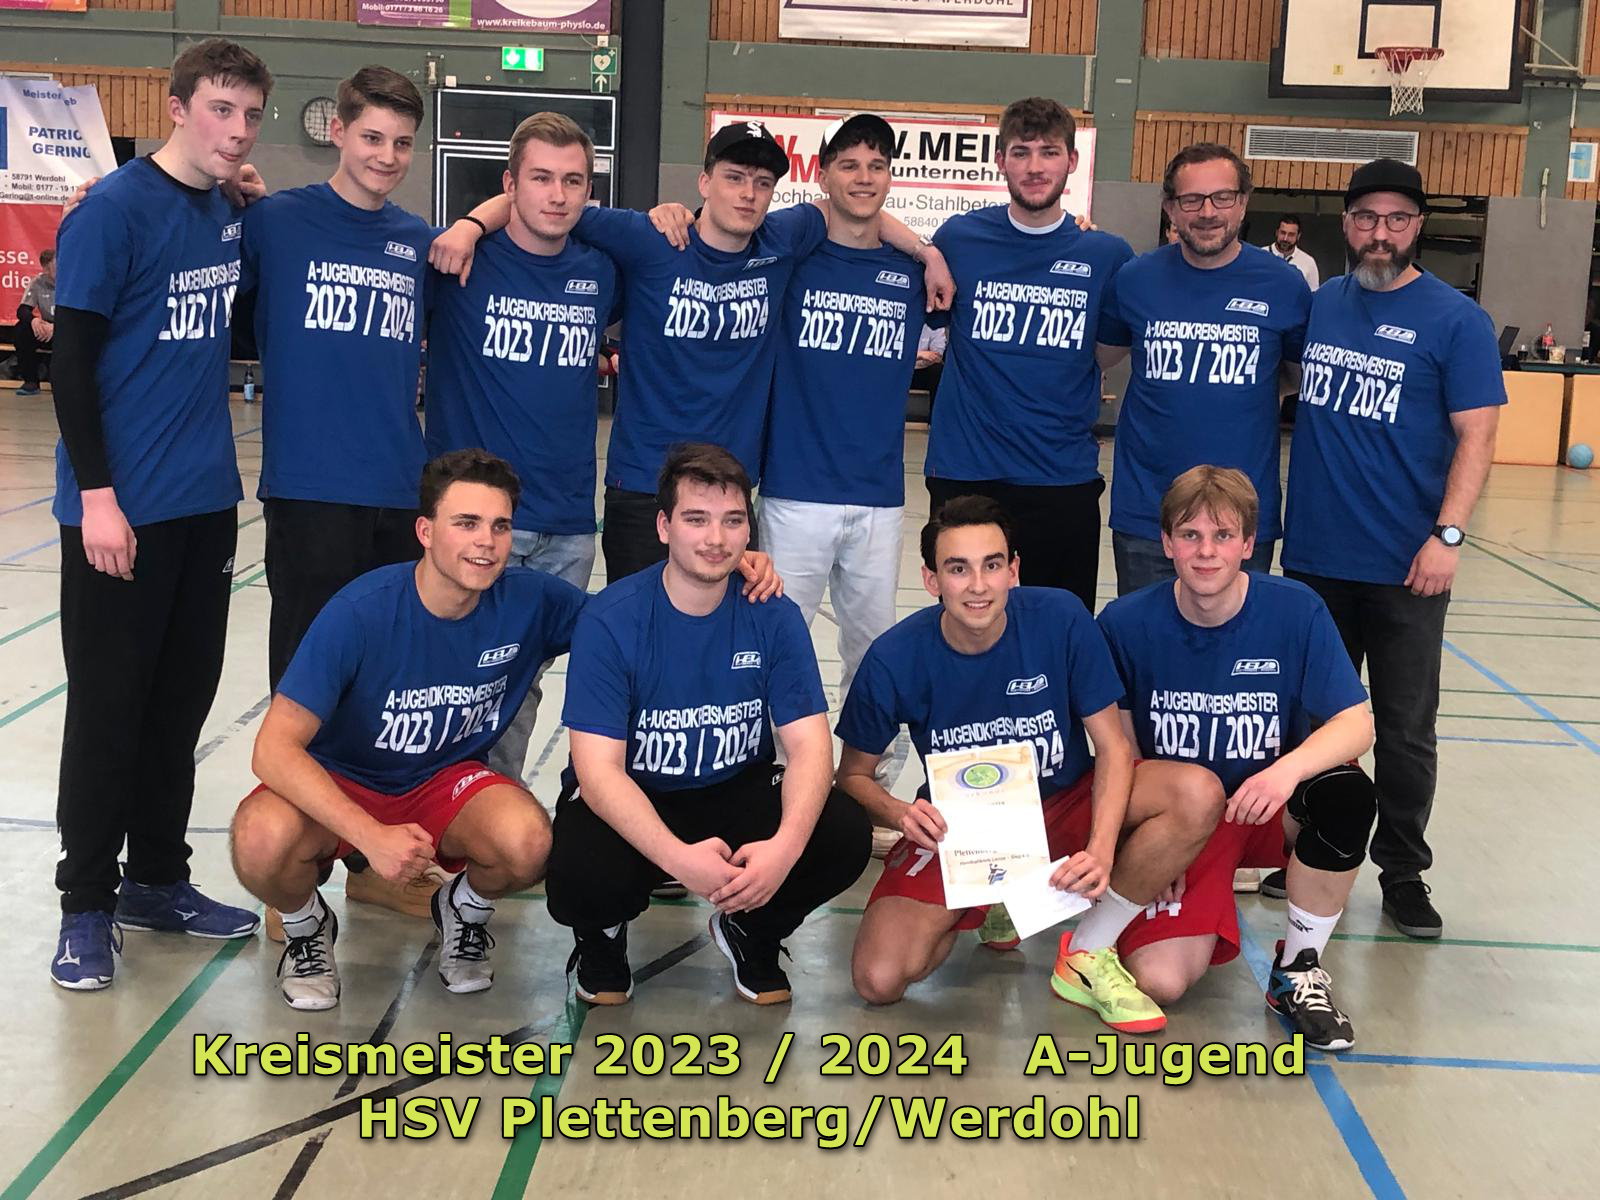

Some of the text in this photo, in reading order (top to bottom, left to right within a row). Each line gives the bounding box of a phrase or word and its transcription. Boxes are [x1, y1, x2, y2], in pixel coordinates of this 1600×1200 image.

[477, 18, 606, 31] www.kreikebaum-physio.de
[919, 131, 1000, 164] MEI
[772, 188, 830, 204] ochba
[2, 270, 32, 289] die
[308, 260, 415, 297] A-JUGENDKREISMEISTER
[672, 277, 768, 303] A-JUGENDKREISMEISTER
[975, 280, 1088, 309] A-JUGENDKREISMEISTER
[305, 283, 357, 332] 2023
[380, 292, 415, 343] 2024
[487, 294, 597, 325] A-JUGENDKREISMEISTER
[664, 295, 710, 339] 2023
[730, 296, 769, 339] 2024
[803, 289, 907, 320] A-JUGENDKREISMEISTER
[483, 315, 533, 363] 2023
[558, 324, 596, 367] 2024
[798, 308, 844, 351] 2023
[863, 316, 905, 360] 2024
[971, 300, 1016, 342] 2023
[1036, 306, 1086, 350] 2024
[1144, 320, 1260, 343] A-JUGENDKREISMEISTER
[1143, 340, 1183, 381] 2023
[1208, 343, 1260, 385] 2024
[1298, 361, 1333, 407] 2023
[1348, 373, 1403, 424] 2024
[385, 674, 508, 710] A-JUGENDKREISMEISTER
[1150, 689, 1278, 715] A-JUGENDKREISMEISTER
[374, 711, 434, 754] 2023
[452, 693, 505, 744] 2024
[638, 698, 763, 730] A-JUGENDKREISMEISTER
[931, 709, 1057, 747] A-JUGENDKREISMEISTER
[632, 730, 687, 776] 2023
[712, 717, 763, 771] 2024
[1150, 711, 1200, 759] 2023
[1226, 714, 1280, 760] 2024
